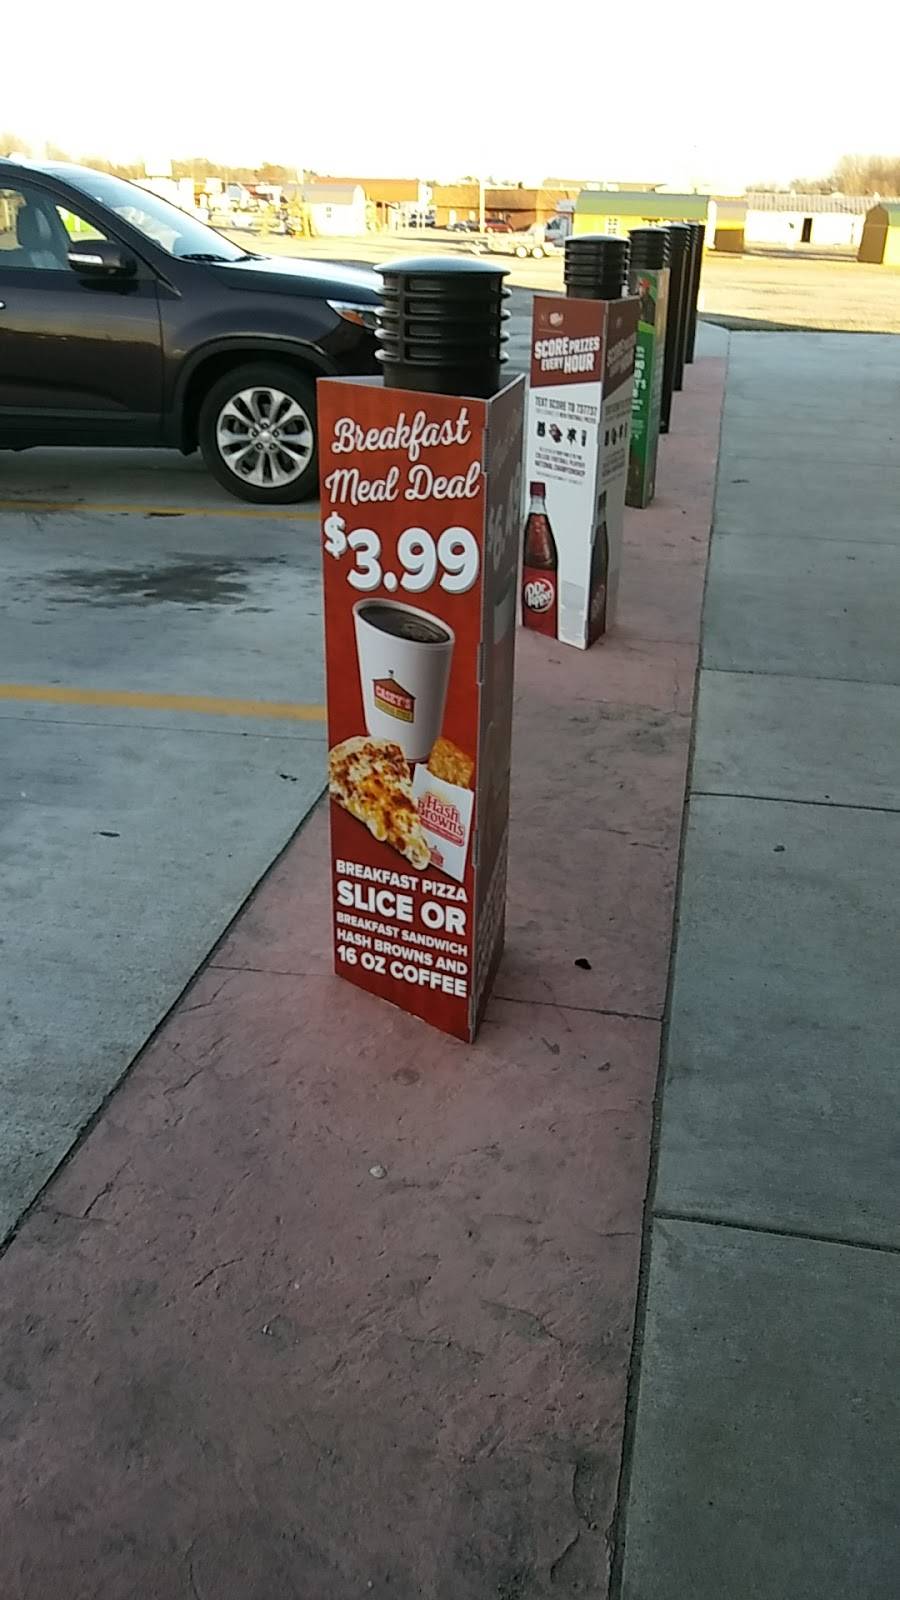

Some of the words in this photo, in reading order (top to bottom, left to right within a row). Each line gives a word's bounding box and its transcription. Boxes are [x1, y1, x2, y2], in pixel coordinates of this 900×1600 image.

[535, 337, 569, 359] SCORE
[569, 336, 601, 351] PRIZES
[541, 357, 564, 372] EVERY
[564, 353, 595, 375] HOUR
[331, 407, 471, 462] Breakfast
[324, 466, 400, 506] Meal
[405, 461, 481, 500] Deal
[324, 511, 480, 594] $3.99
[417, 798, 465, 836] Browns
[426, 795, 459, 822] Hash
[336, 859, 419, 891] BREAKFAST
[422, 879, 468, 903] PIZZA
[336, 880, 414, 923] SLICE
[421, 901, 466, 936] OR
[336, 912, 400, 938] BREAKFAST
[401, 930, 468, 957] SANDWICH
[336, 929, 372, 949] HASH
[374, 939, 434, 966] BROWNS
[435, 956, 468, 976] AND
[337, 944, 358, 966] 16
[361, 952, 387, 975] OZ
[390, 961, 467, 998] COFFEE
